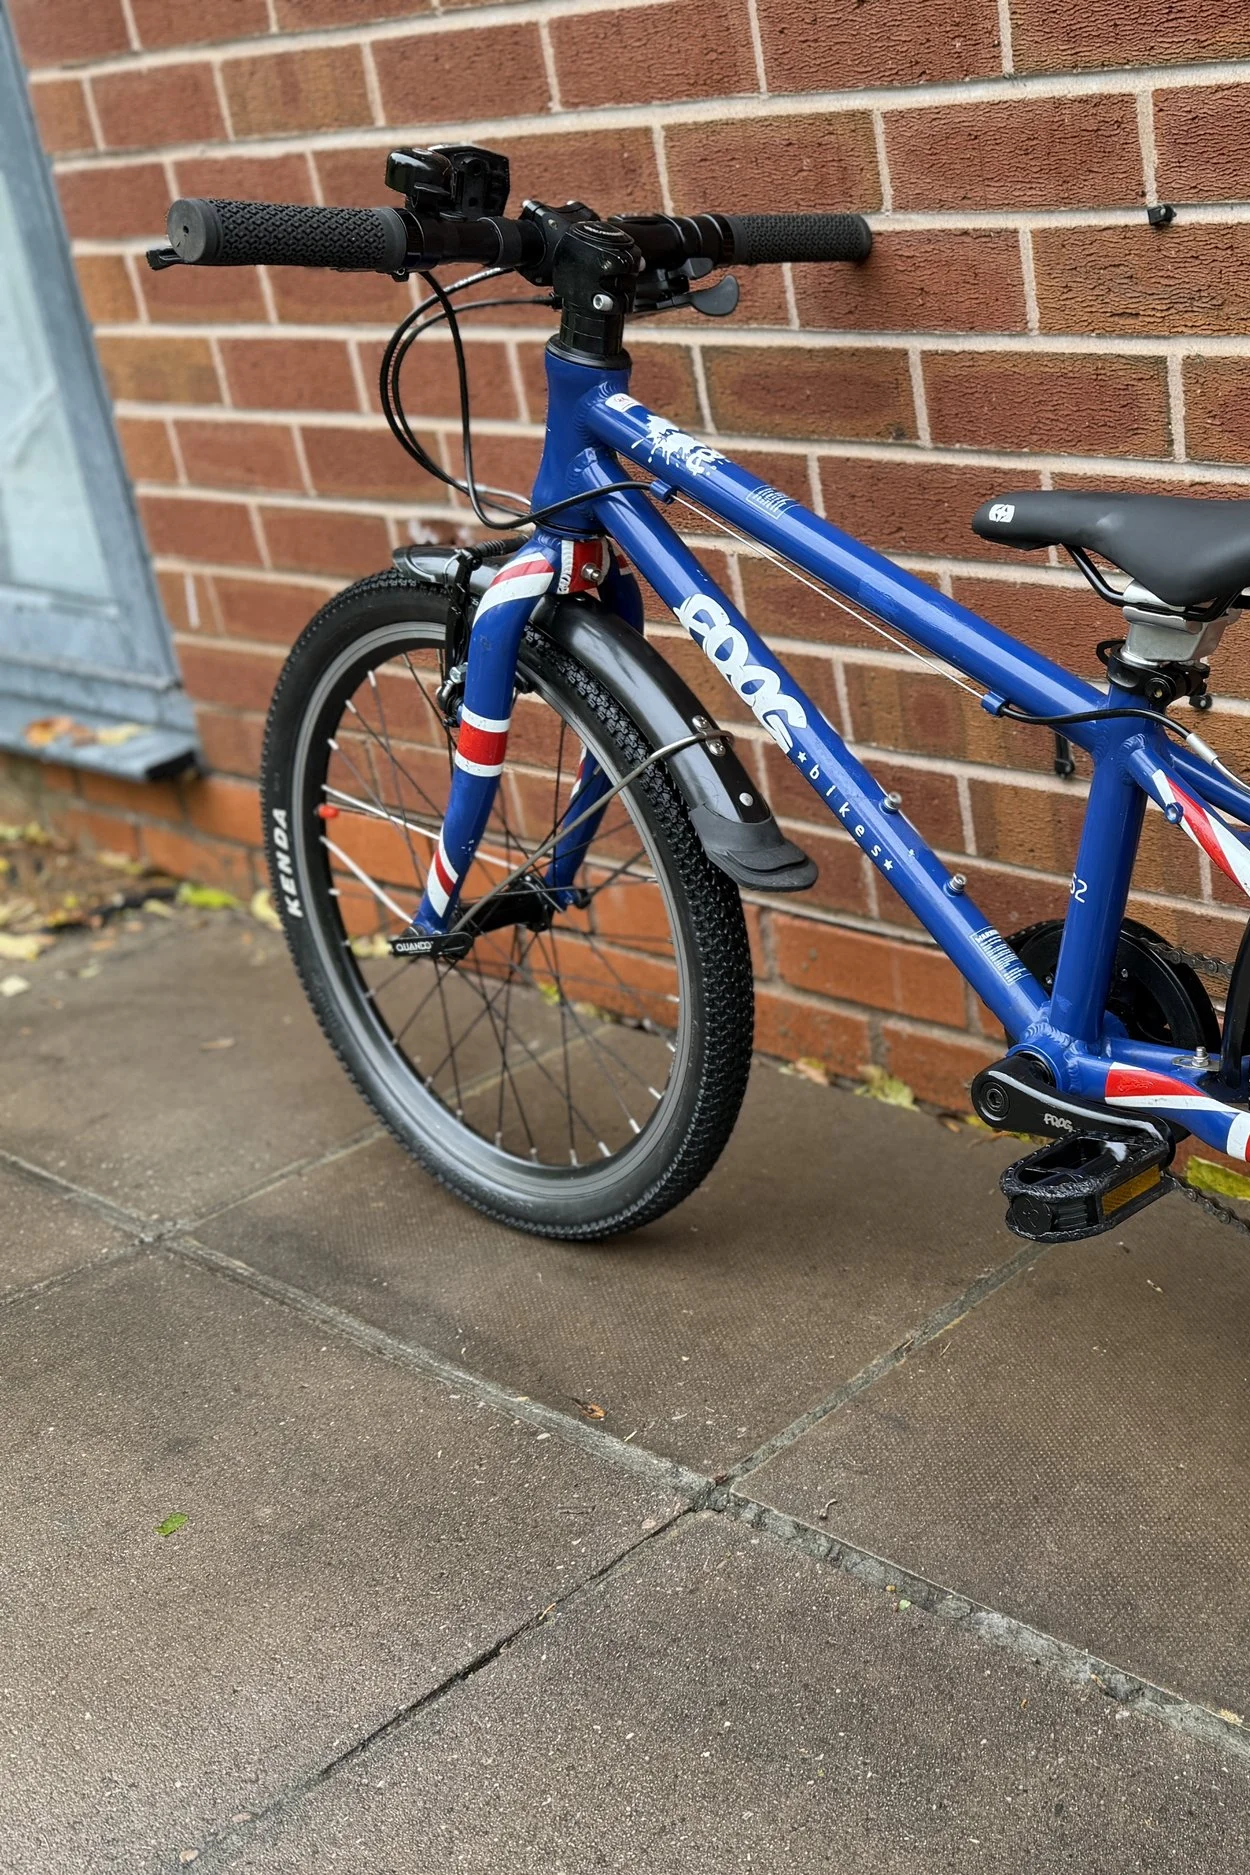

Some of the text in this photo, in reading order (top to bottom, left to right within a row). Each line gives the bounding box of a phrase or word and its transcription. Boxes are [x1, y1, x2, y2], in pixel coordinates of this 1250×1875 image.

[809, 763, 882, 858] bikes
[273, 808, 304, 918] KENDA
[396, 941, 432, 952] QUANDO
[1044, 1113, 1074, 1133] FROG
